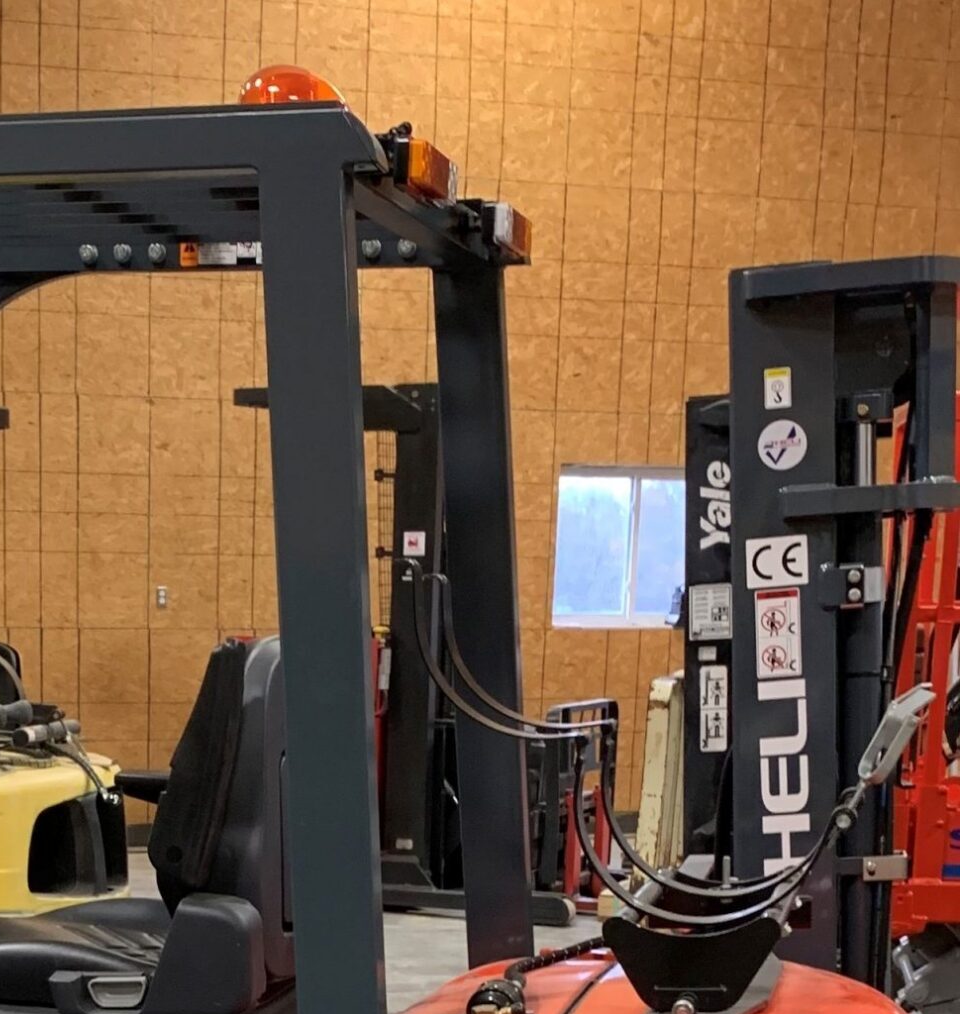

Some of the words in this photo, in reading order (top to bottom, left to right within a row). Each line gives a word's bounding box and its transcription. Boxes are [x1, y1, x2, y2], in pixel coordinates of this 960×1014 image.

[700, 461, 731, 550] Yale
[752, 542, 803, 580] CE
[757, 678, 811, 878] HELI
